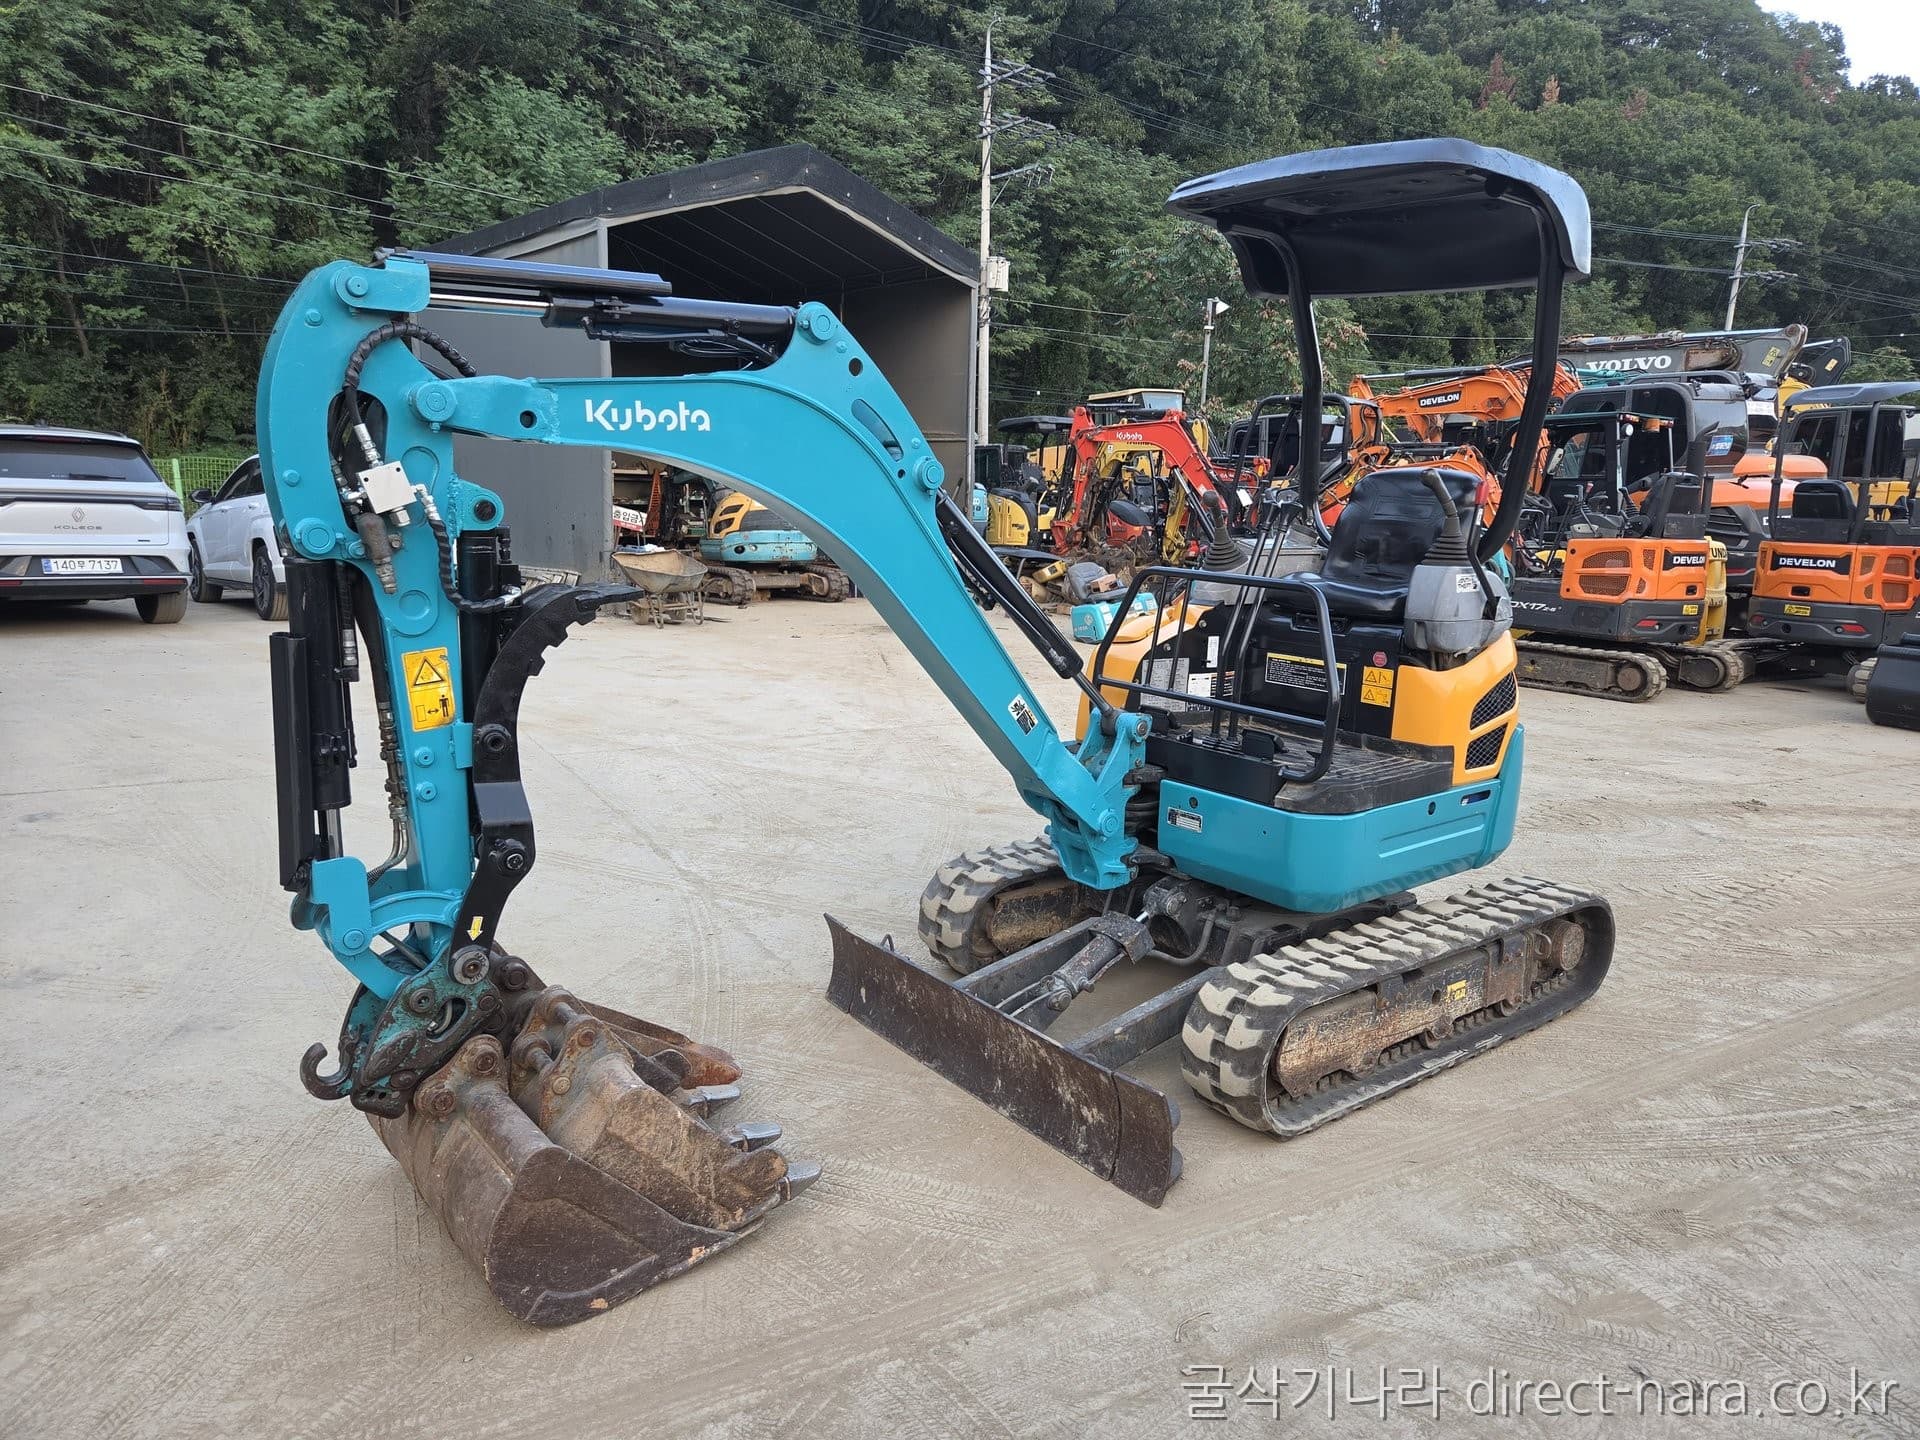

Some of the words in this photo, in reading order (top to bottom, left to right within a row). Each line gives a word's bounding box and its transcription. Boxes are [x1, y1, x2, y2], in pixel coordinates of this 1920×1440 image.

[1586, 355, 1672, 371] VOLVO
[1420, 393, 1460, 407] DEVELON
[584, 399, 711, 431] Kubota
[1116, 431, 1143, 441] Kubota
[88, 560, 118, 570] 7137
[1779, 557, 1837, 568] DEVELON
